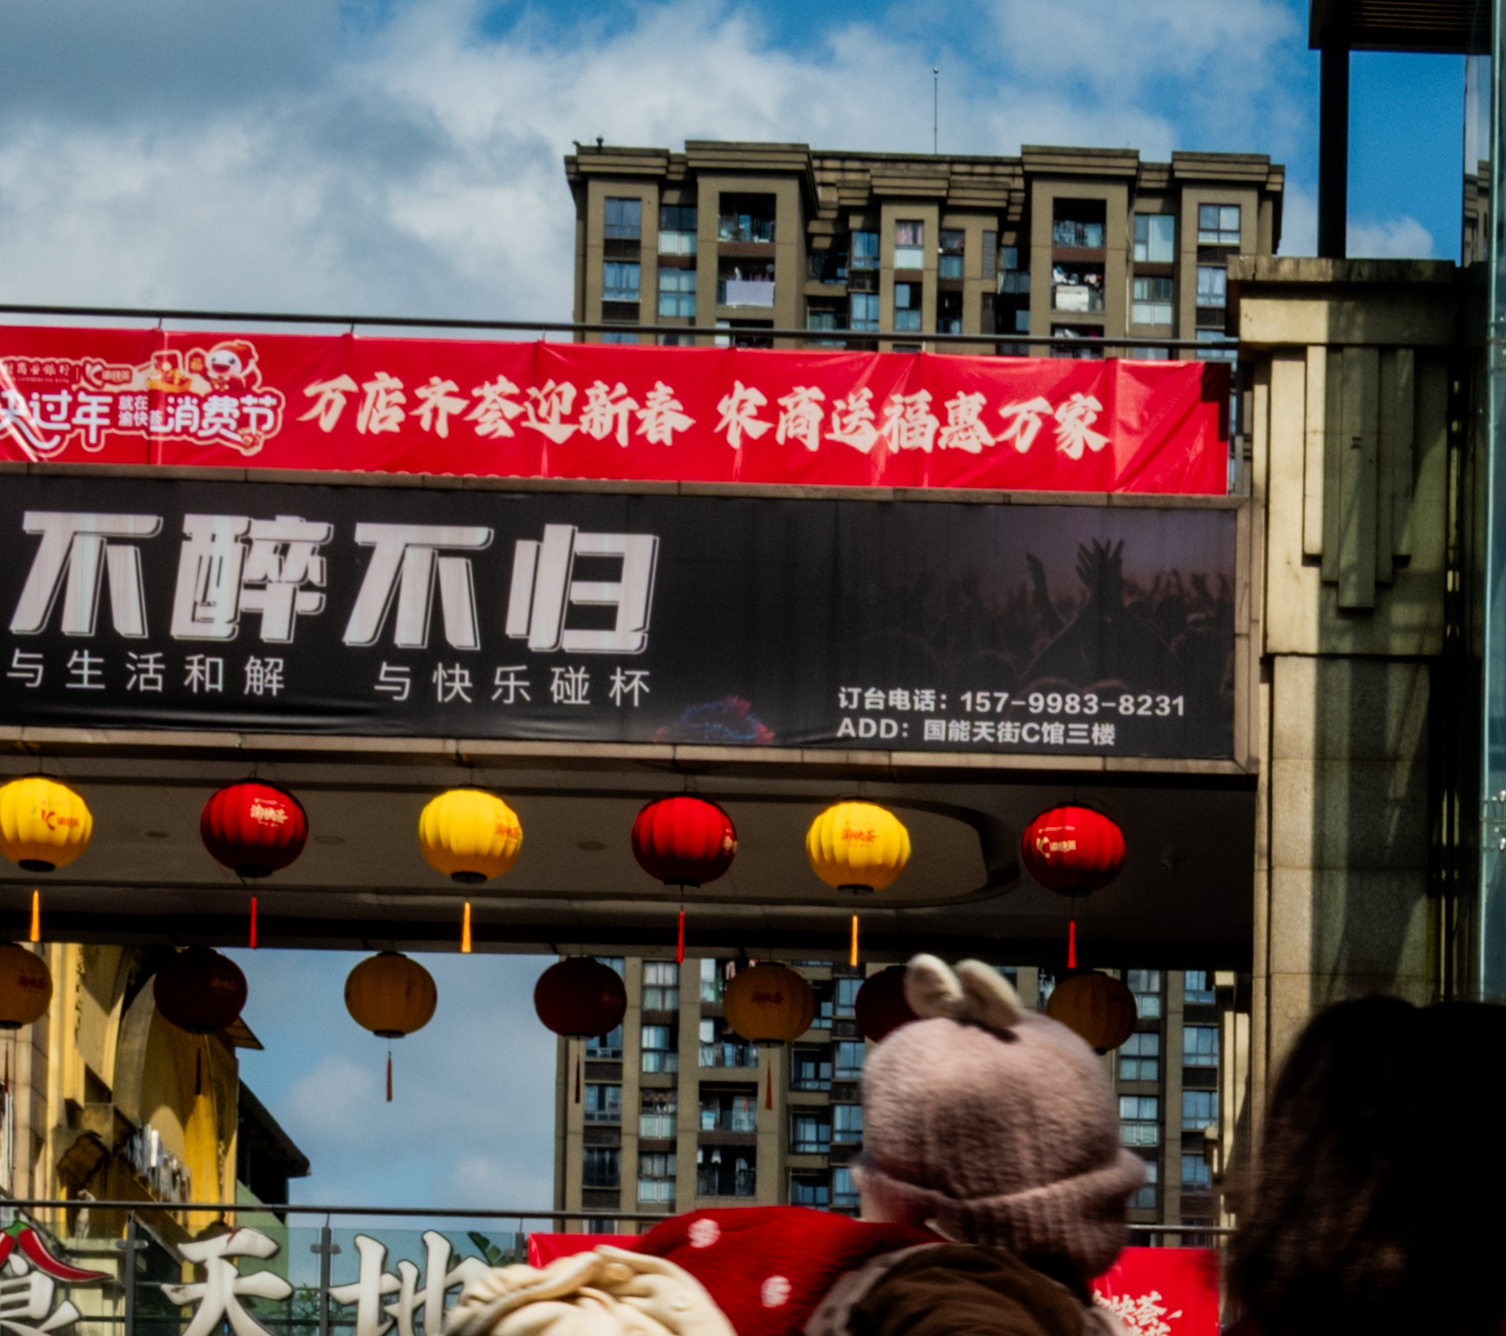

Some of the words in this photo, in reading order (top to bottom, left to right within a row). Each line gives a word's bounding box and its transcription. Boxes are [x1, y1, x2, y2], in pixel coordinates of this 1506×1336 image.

[296, 370, 696, 448] 万店齐荟迎新春
[715, 379, 1112, 461] 农商送福惠万家
[8, 509, 661, 654] 不醉不归
[7, 649, 286, 696] 与生活和解
[374, 661, 651, 707] 与快乐碰杯
[1094, 1288, 1167, 1328] 快荟
